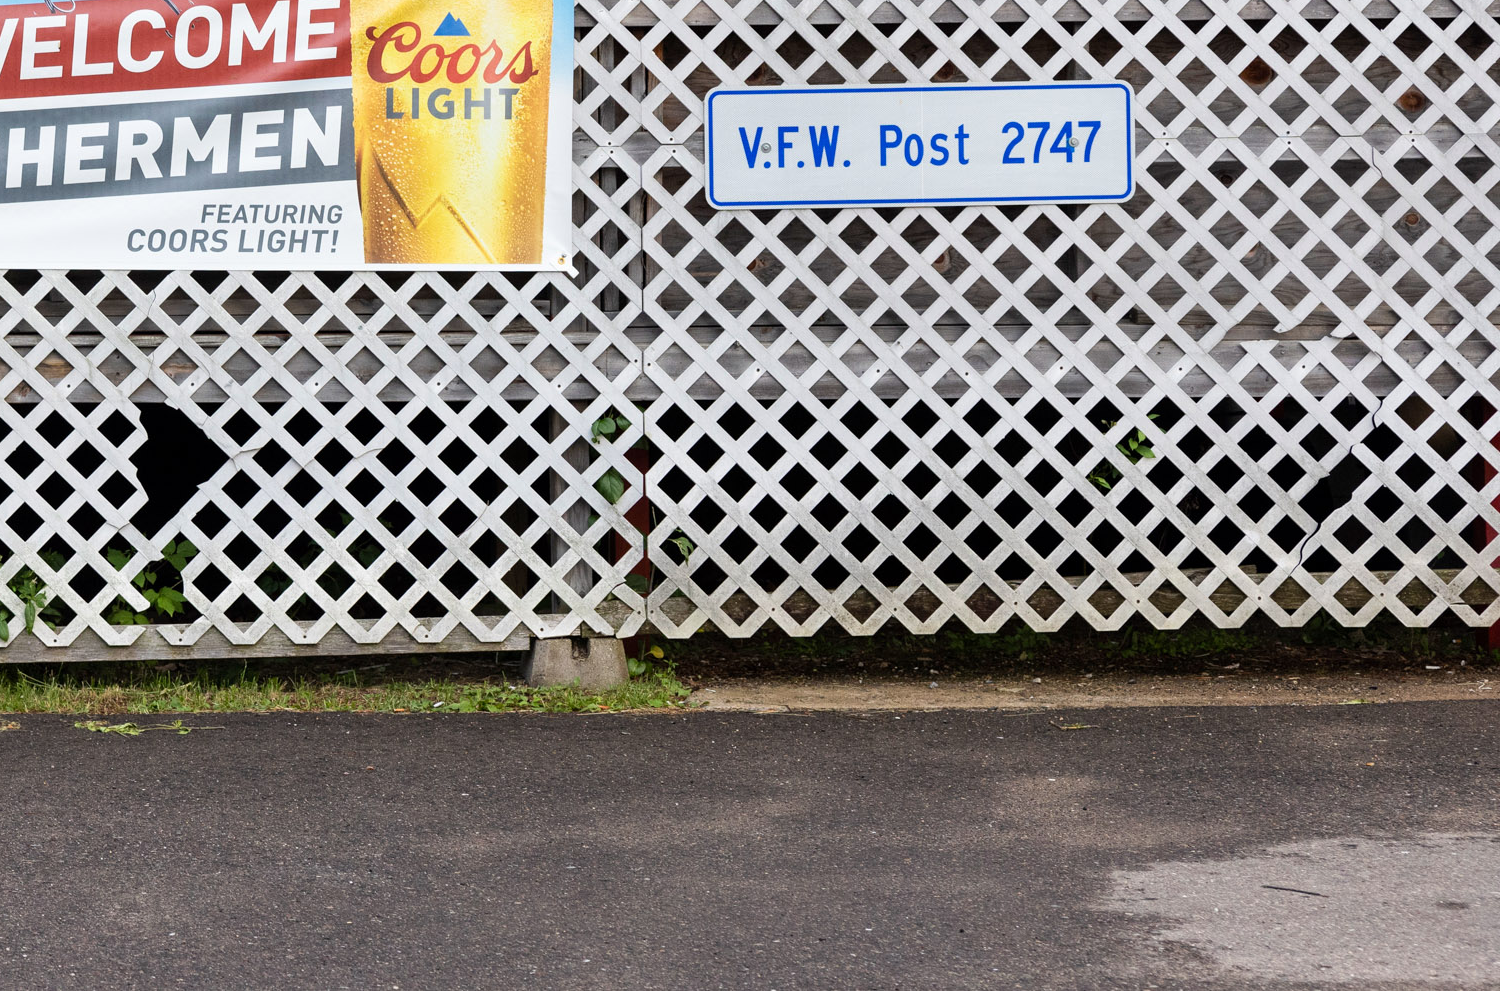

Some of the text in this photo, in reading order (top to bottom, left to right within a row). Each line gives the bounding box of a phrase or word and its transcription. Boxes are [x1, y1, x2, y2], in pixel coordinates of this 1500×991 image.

[366, 21, 539, 84] Coors
[386, 87, 520, 120] LIGHT
[738, 120, 1102, 169] V.F.W. Post 2747
[201, 204, 343, 224] FEATURING
[127, 228, 339, 253] COORS LIGHT!
